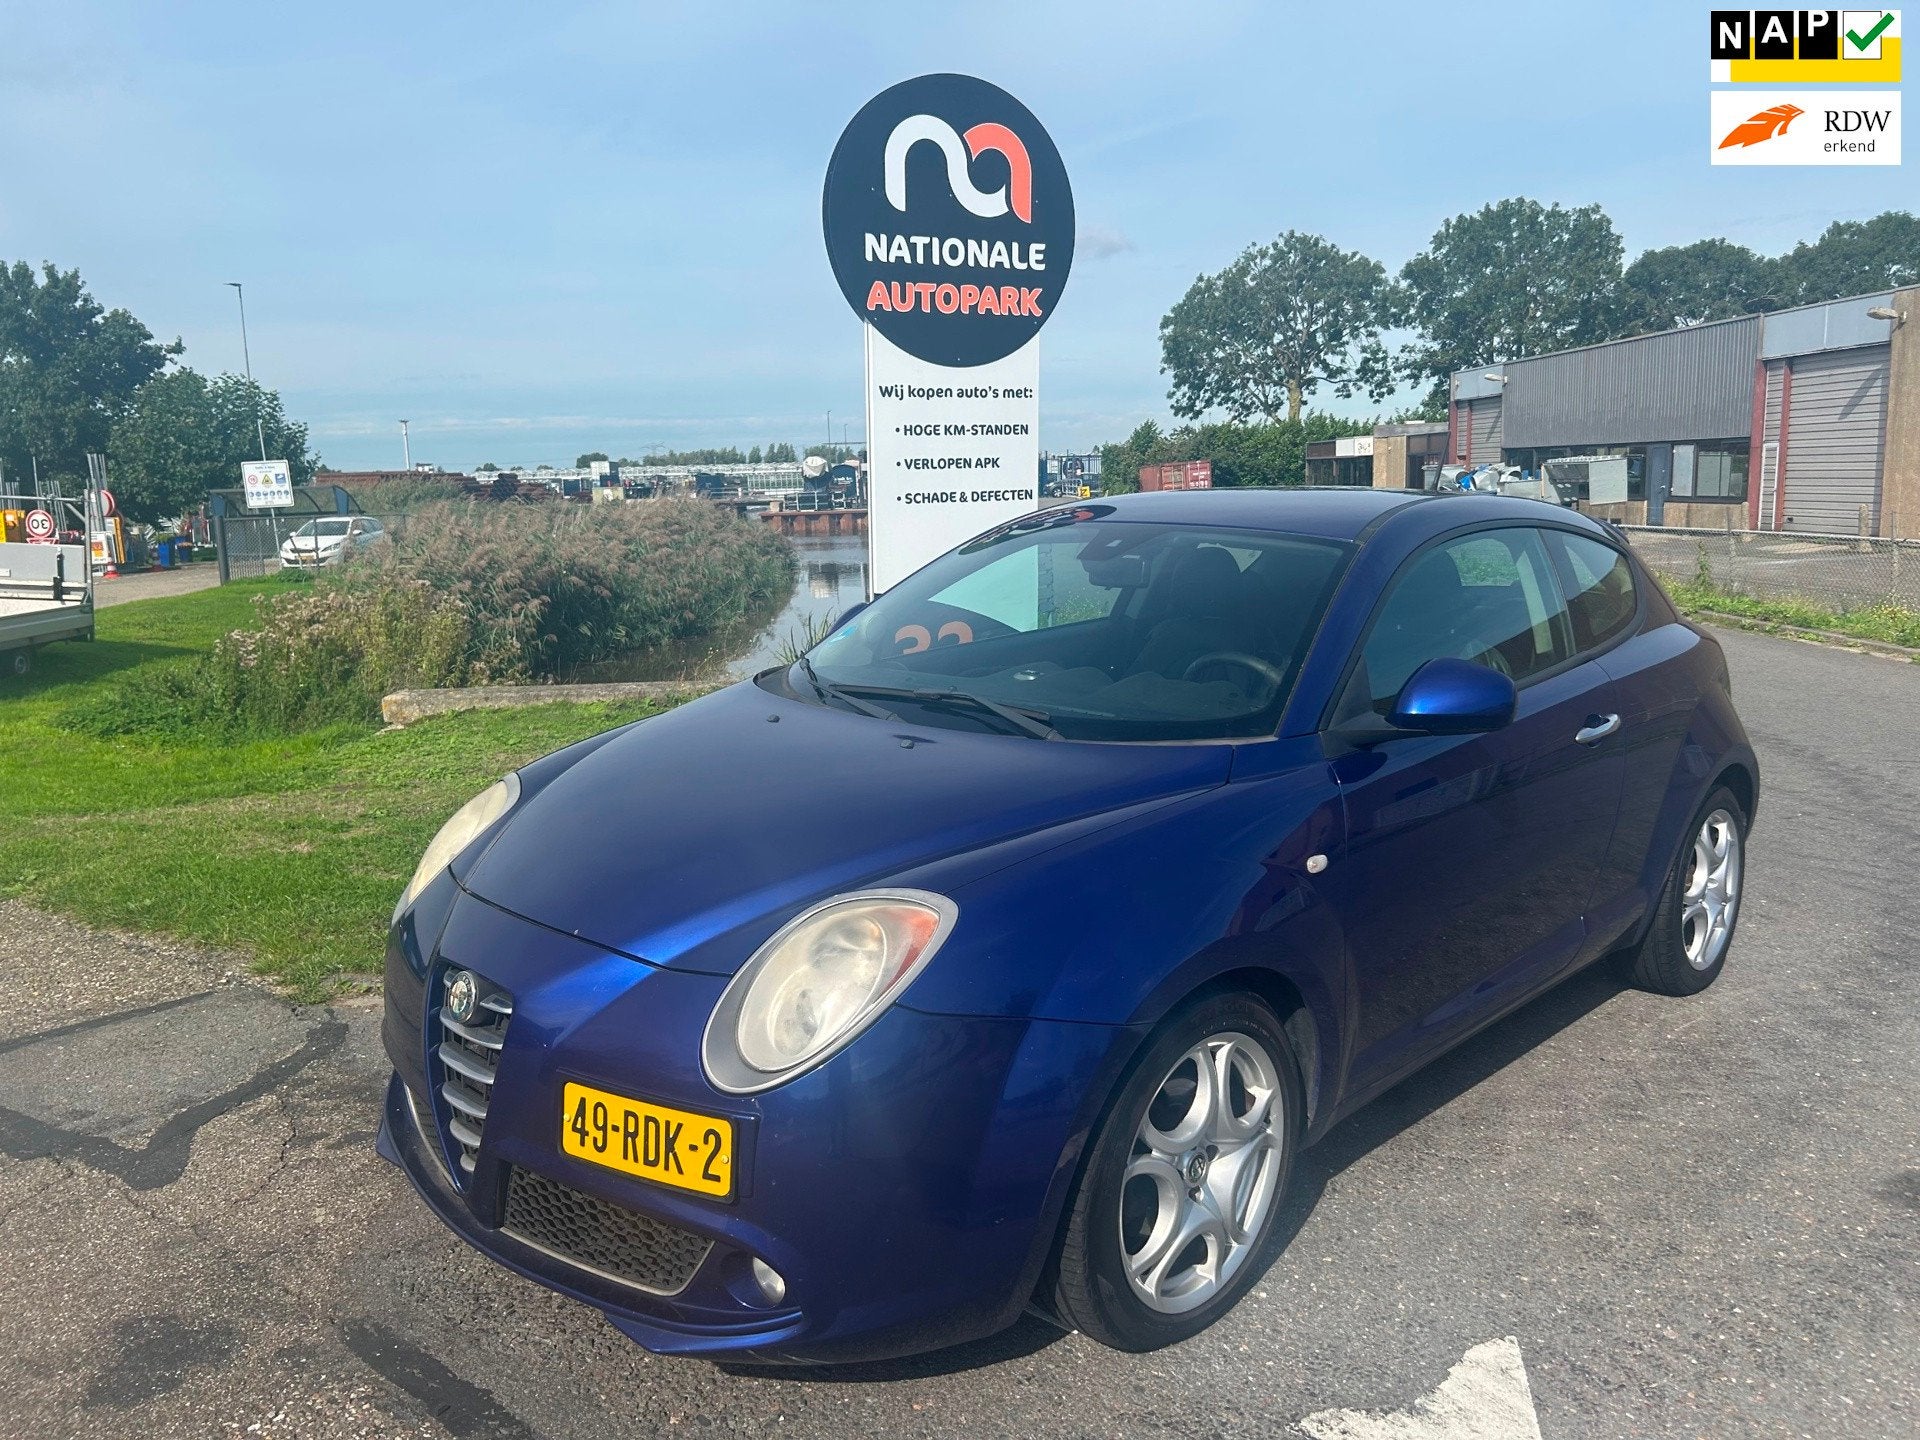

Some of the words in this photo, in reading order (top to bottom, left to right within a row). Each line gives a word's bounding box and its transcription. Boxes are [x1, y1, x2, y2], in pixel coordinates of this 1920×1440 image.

[864, 232, 1046, 271] NATIONALE
[866, 280, 1043, 317] AUTOPARK
[879, 384, 904, 401] Wij
[907, 384, 953, 401] kopen
[956, 385, 999, 399] auto's
[1002, 386, 1034, 399] met:
[903, 424, 941, 436] HOGE
[944, 424, 1029, 436] KM-STANDEN
[904, 457, 972, 470] VERLOPEN
[974, 457, 1001, 469] APK
[904, 491, 957, 505] SCHADE
[958, 490, 969, 503] &
[971, 489, 1034, 503] DEFECTEN
[571, 1096, 722, 1183] 49-RDK-2
